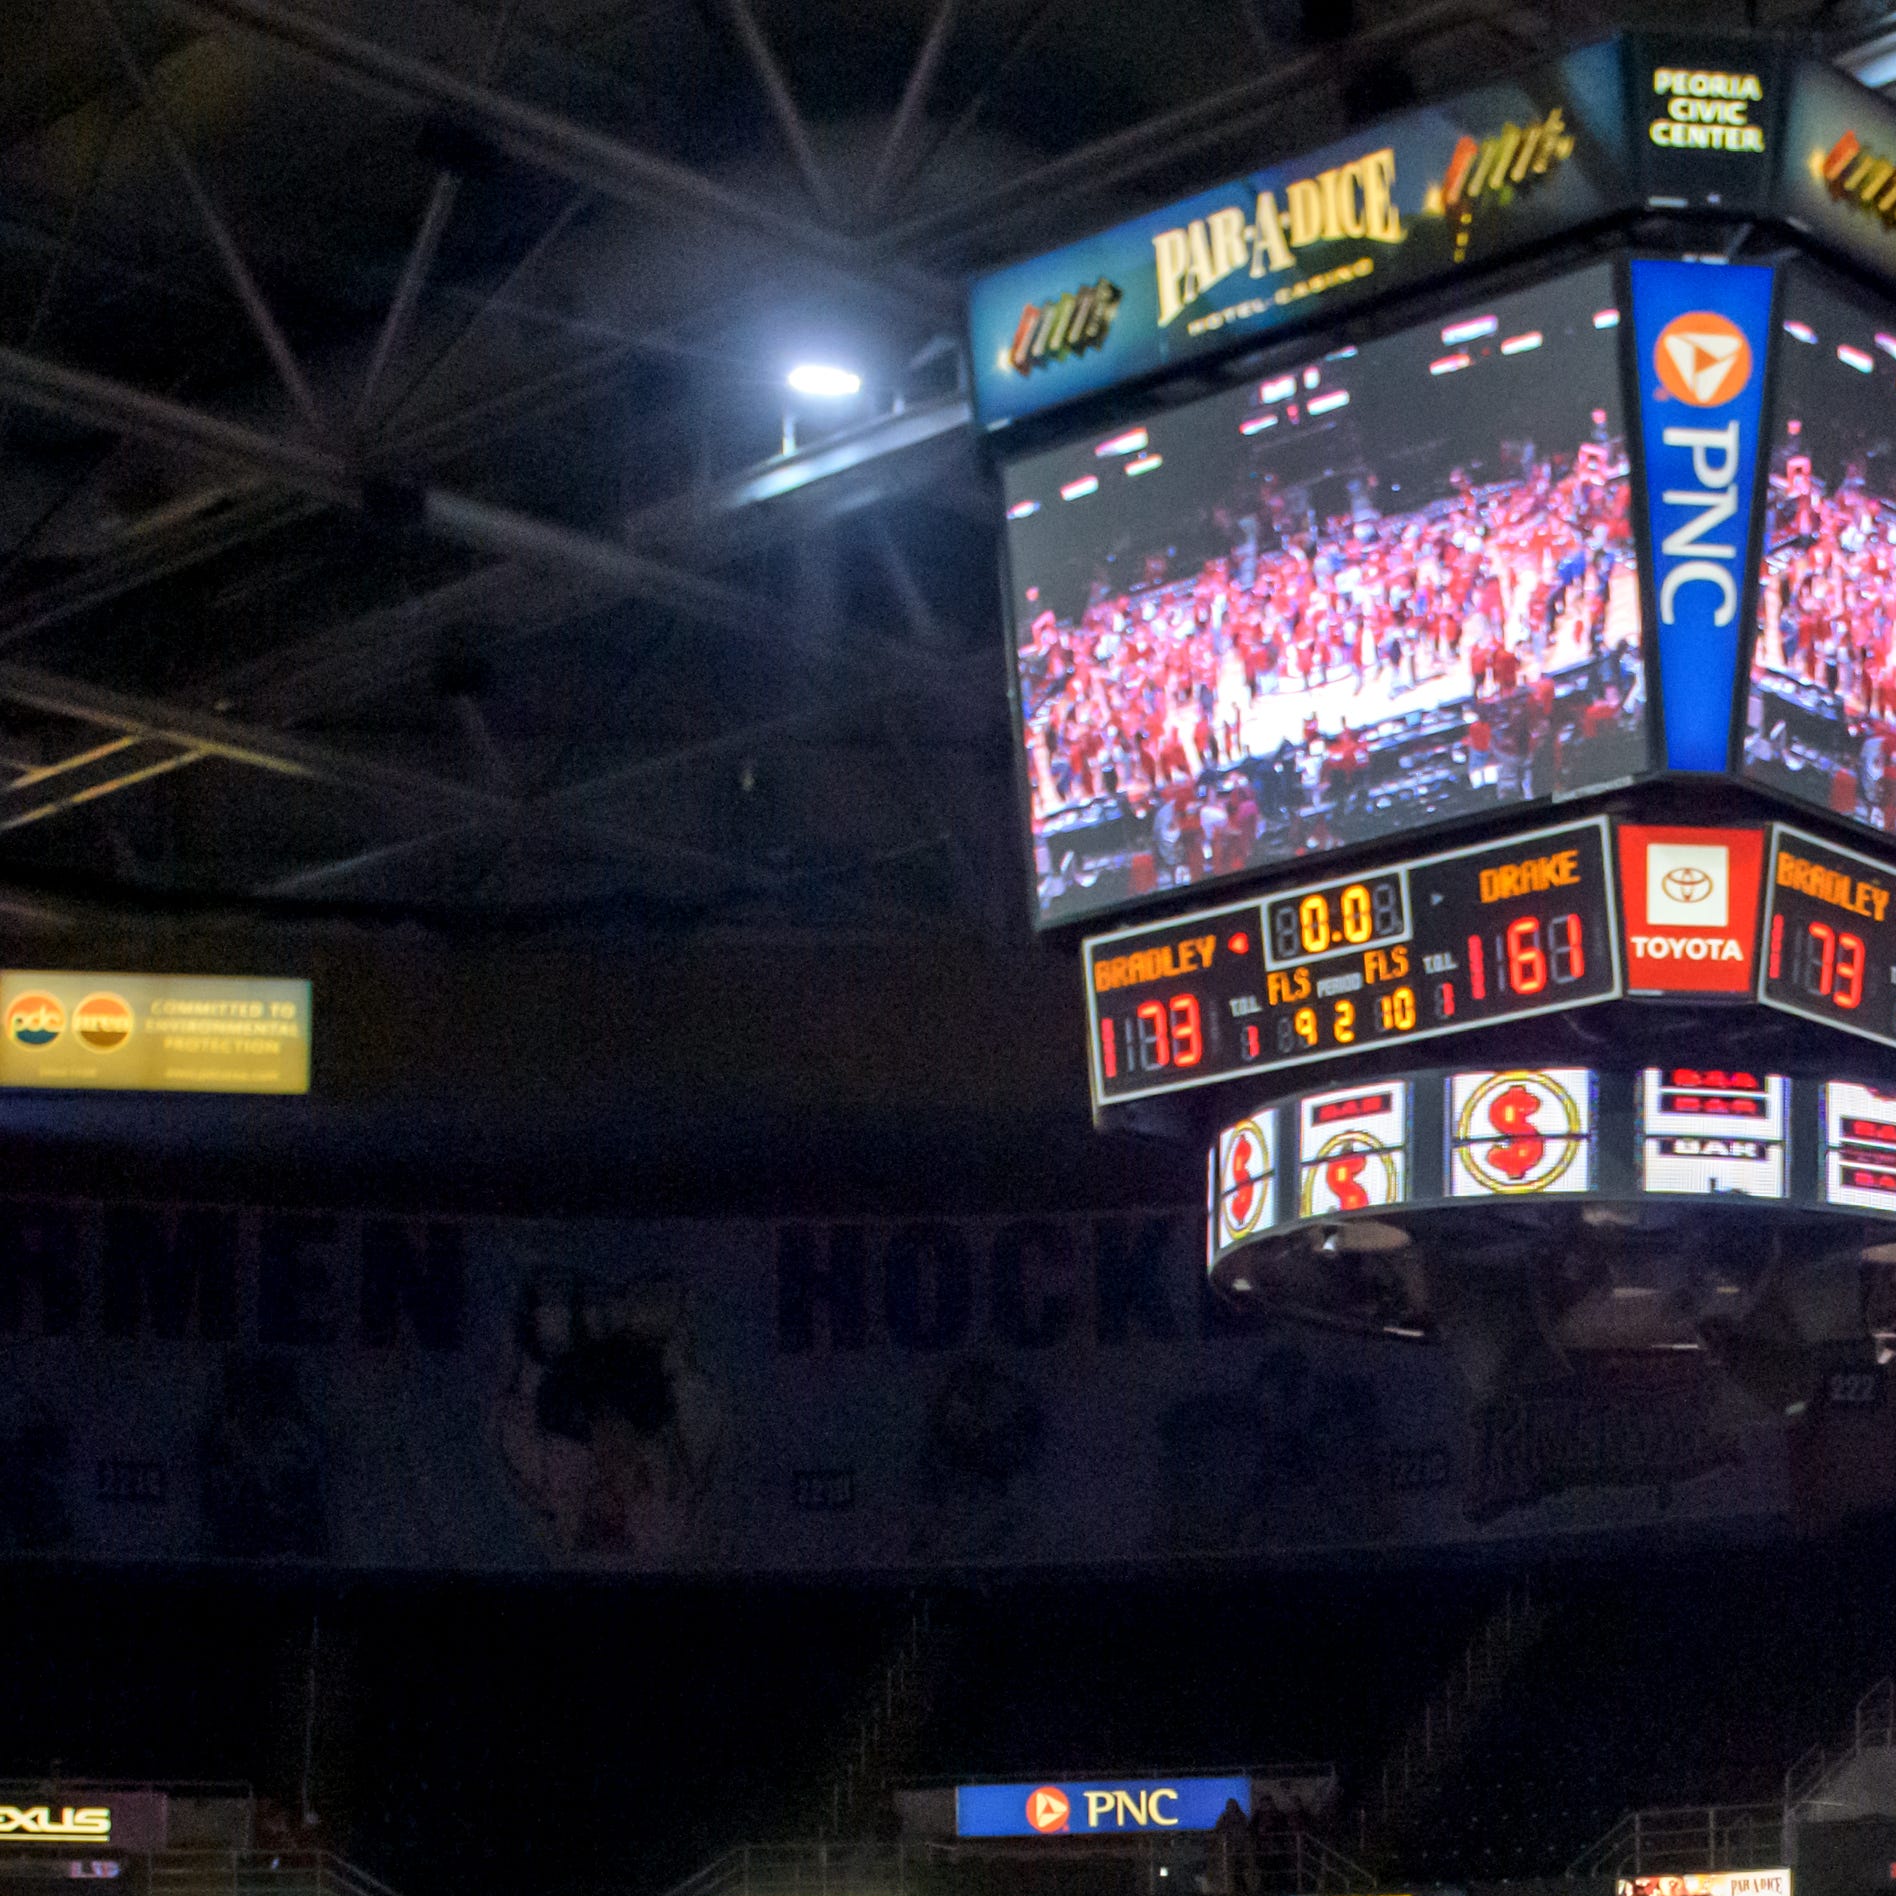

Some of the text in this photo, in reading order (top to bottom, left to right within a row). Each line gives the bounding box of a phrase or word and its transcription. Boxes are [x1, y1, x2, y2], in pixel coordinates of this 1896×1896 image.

[1654, 67, 1762, 101] PEORIA
[1668, 98, 1748, 126] CIVIC
[1649, 120, 1765, 154] CENTER
[1659, 420, 1739, 628] PNC
[1479, 849, 1582, 904] DRAKE
[1776, 851, 1890, 922] BRADLEY
[1094, 934, 1217, 993] BRADLEY
[1363, 945, 1410, 985] FLS
[1630, 936, 1744, 961] TOYOTA
[1266, 966, 1313, 1006] FLS
[151, 999, 296, 1019] COMMITTED TO
[1083, 1787, 1179, 1829] PNC
